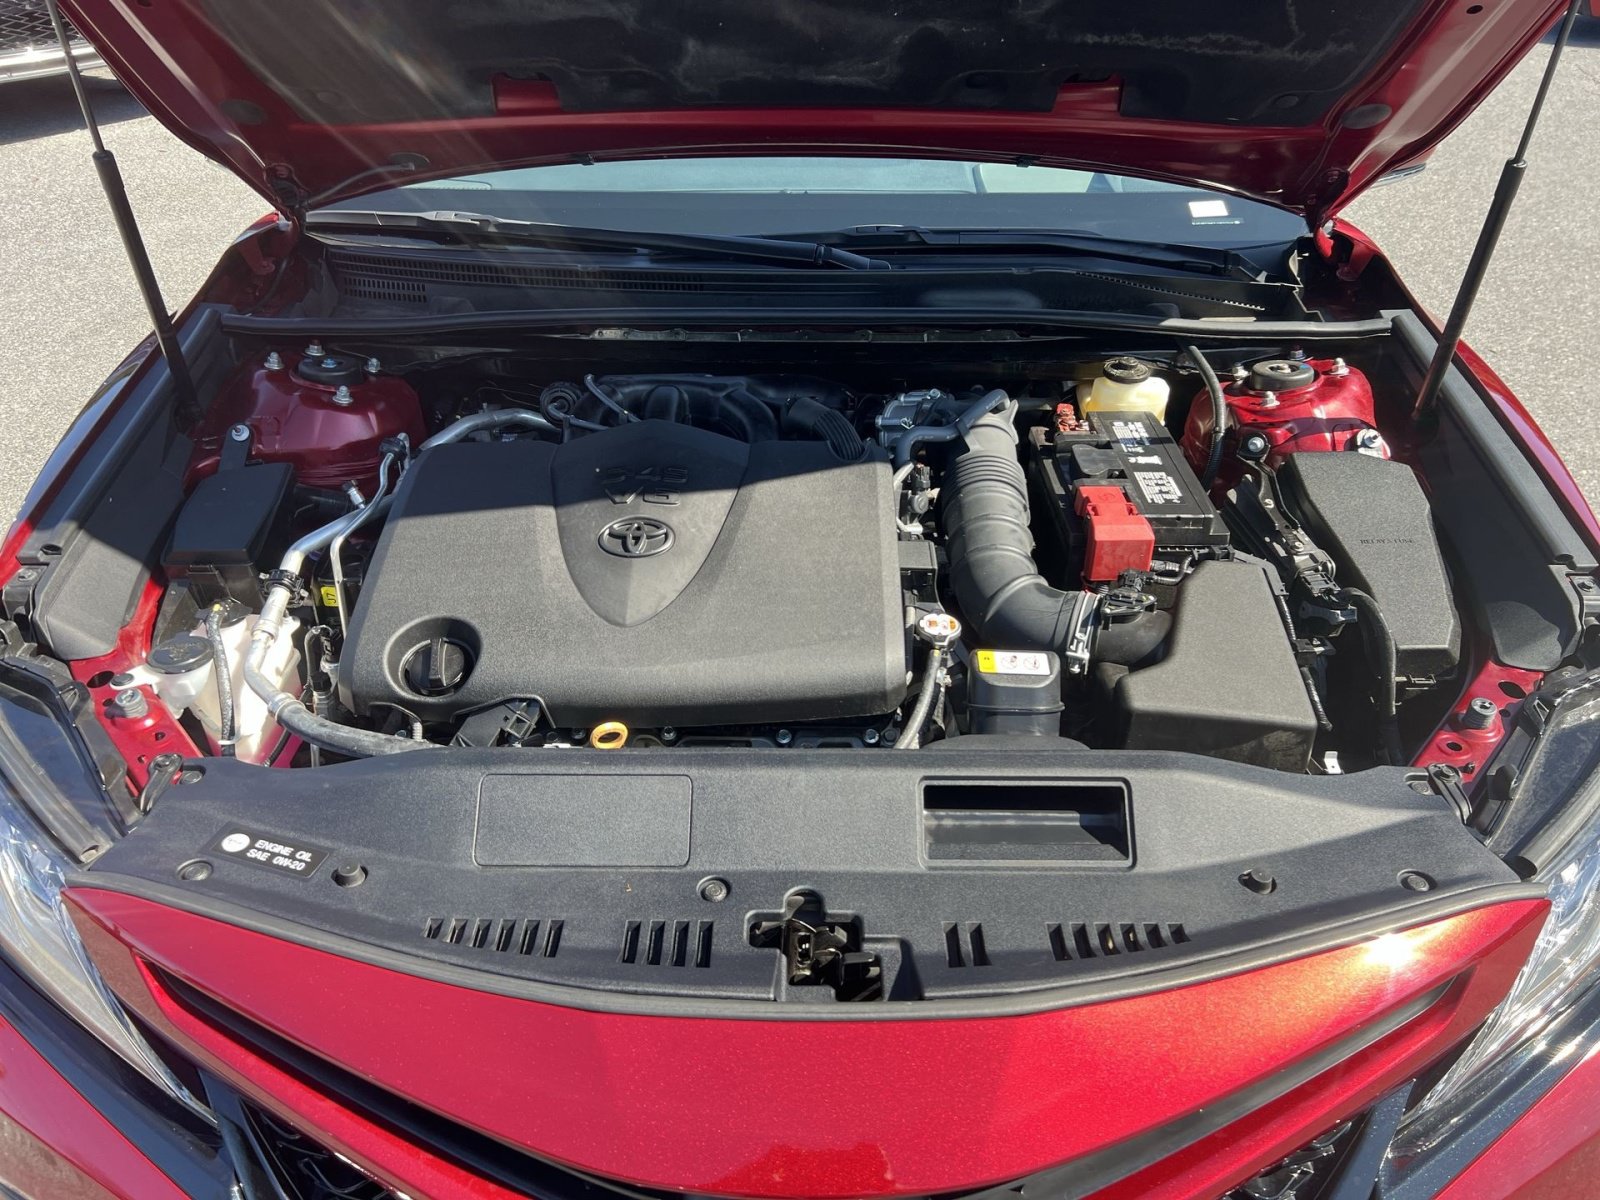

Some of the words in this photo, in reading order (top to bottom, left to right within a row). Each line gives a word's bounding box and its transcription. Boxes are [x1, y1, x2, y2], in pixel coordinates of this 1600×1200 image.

[602, 486, 681, 506] V6
[246, 848, 271, 861] SAE
[254, 839, 294, 856] ENGINE
[295, 850, 312, 862] OIL
